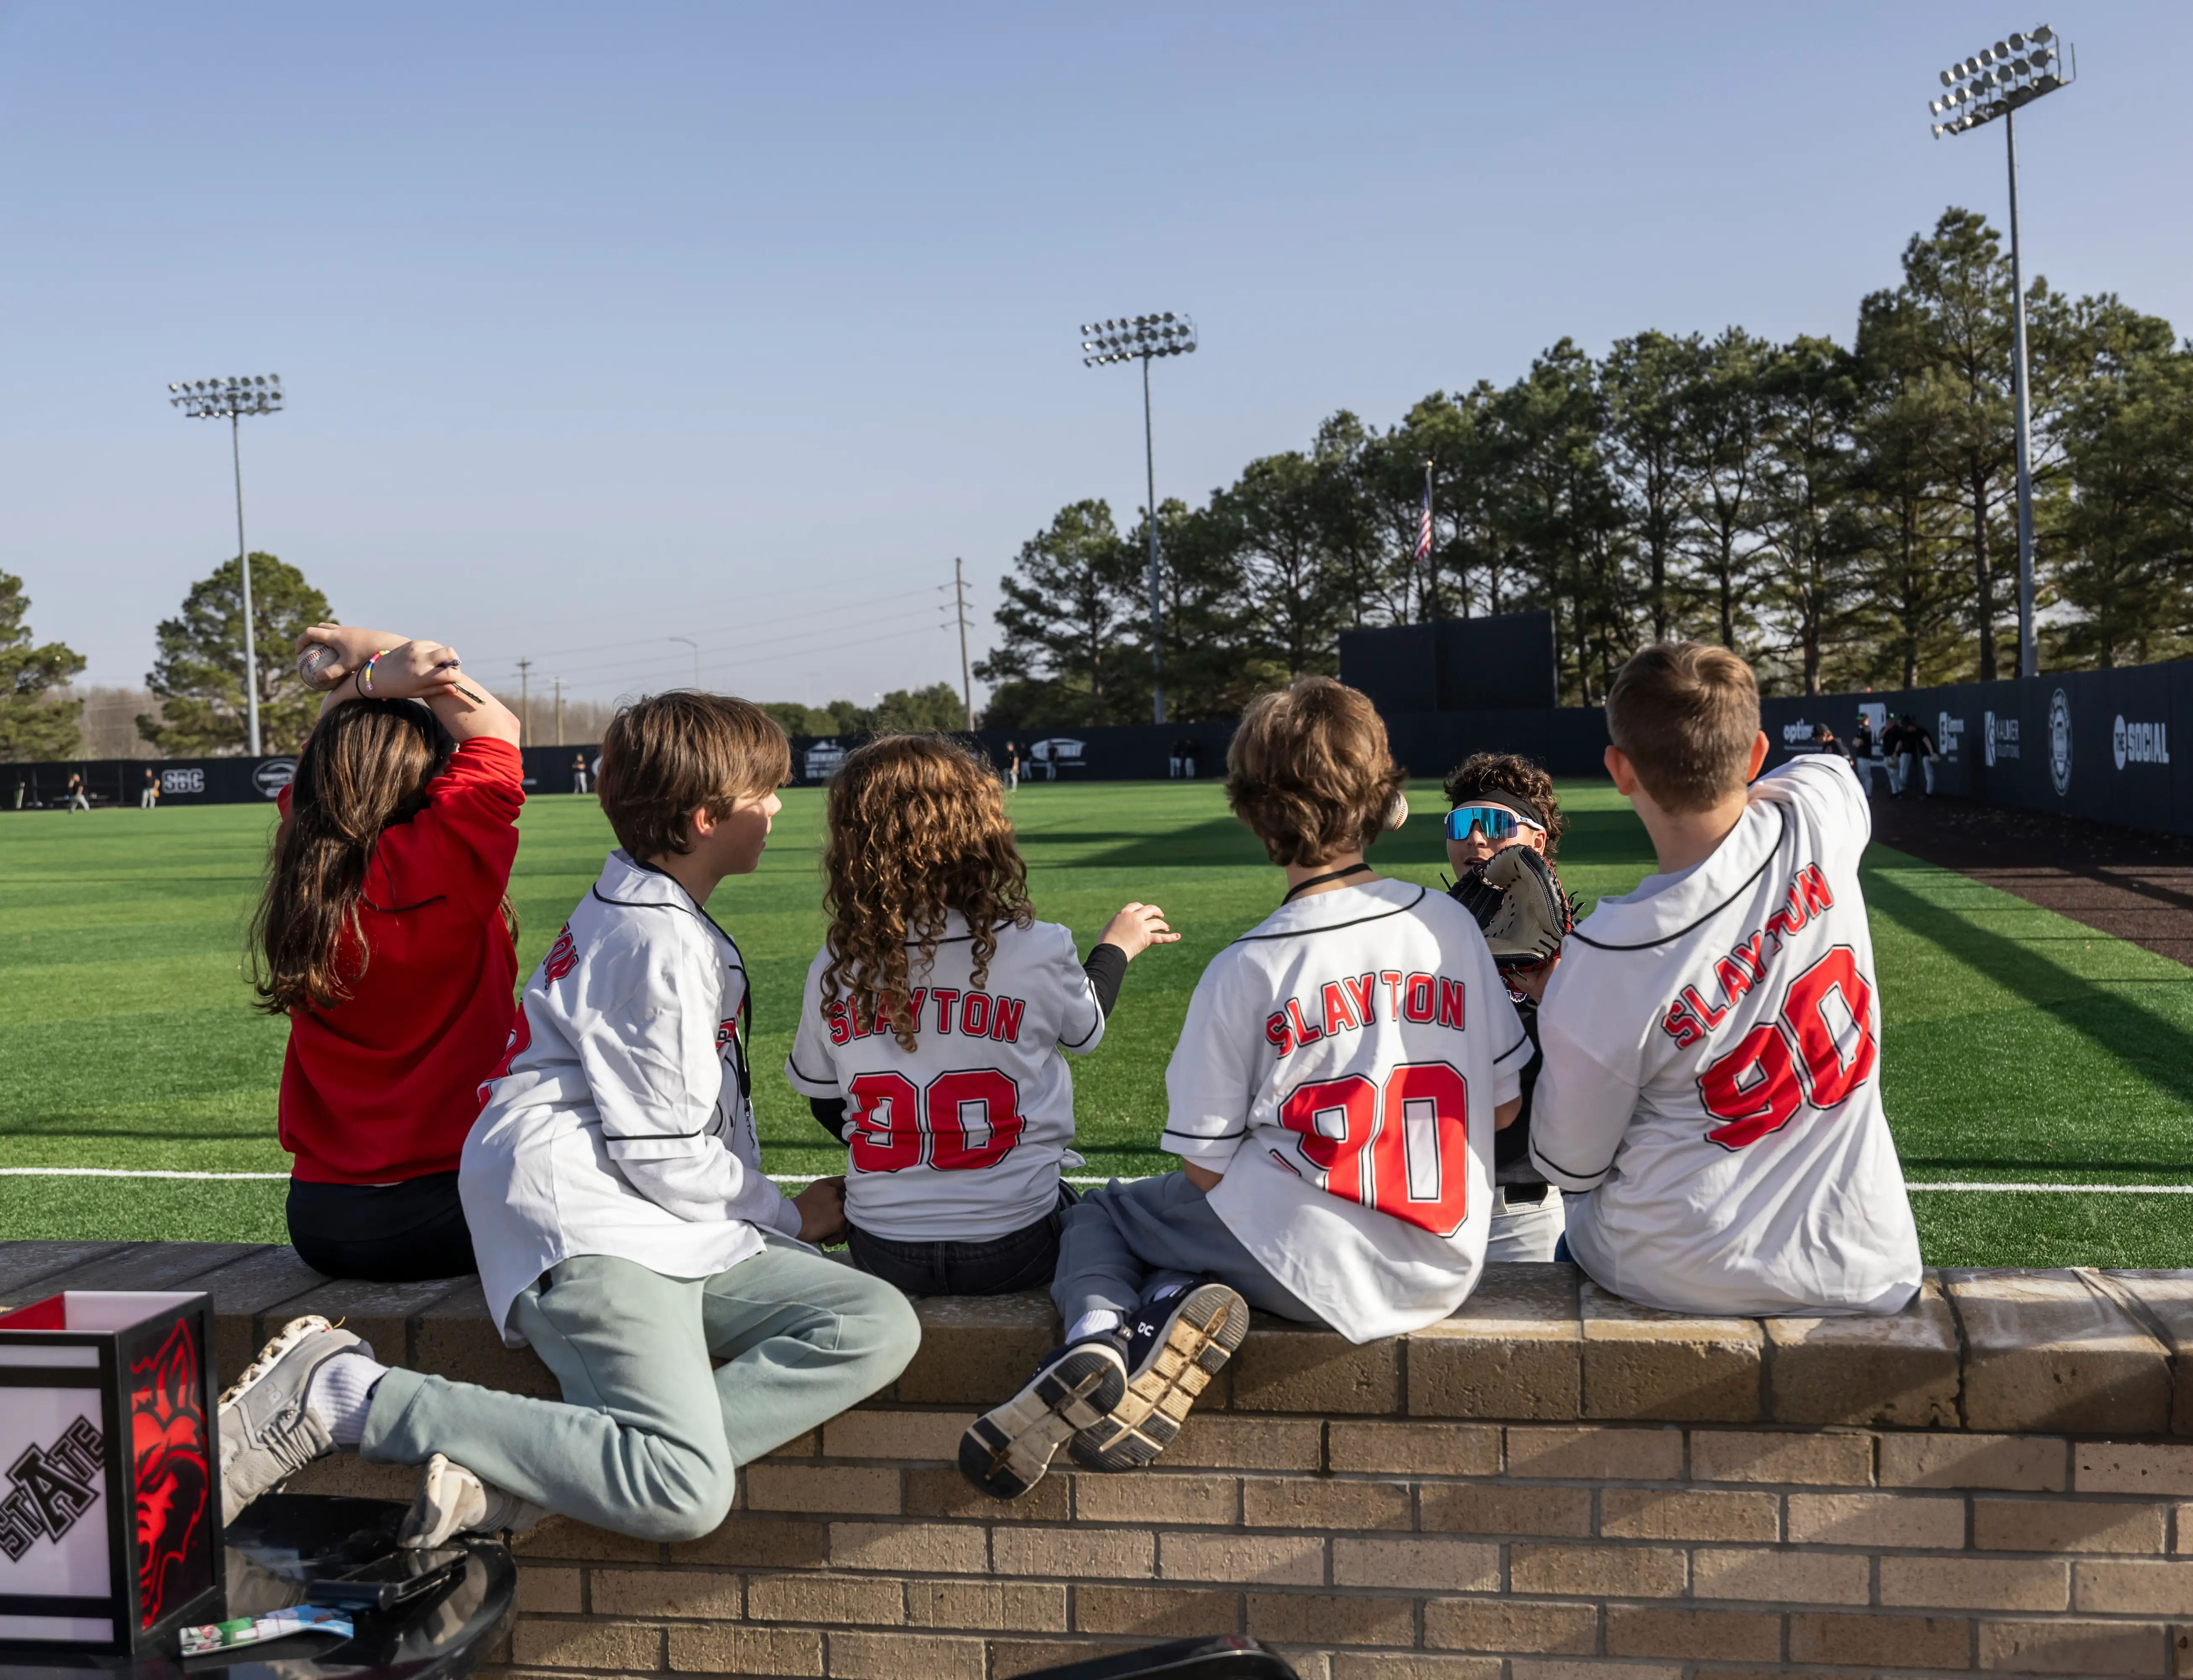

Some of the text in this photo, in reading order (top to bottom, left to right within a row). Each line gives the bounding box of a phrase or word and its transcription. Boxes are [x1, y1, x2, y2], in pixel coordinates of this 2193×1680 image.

[2127, 722, 2170, 764] SOCIAL
[1661, 862, 1834, 1050] SLAYTON
[829, 987, 1026, 1046] SLAYTON
[1265, 970, 1466, 1059] SLAYTON
[1695, 944, 1877, 1152] 90
[847, 1067, 1027, 1174] 90
[1269, 1060, 1469, 1239] 90
